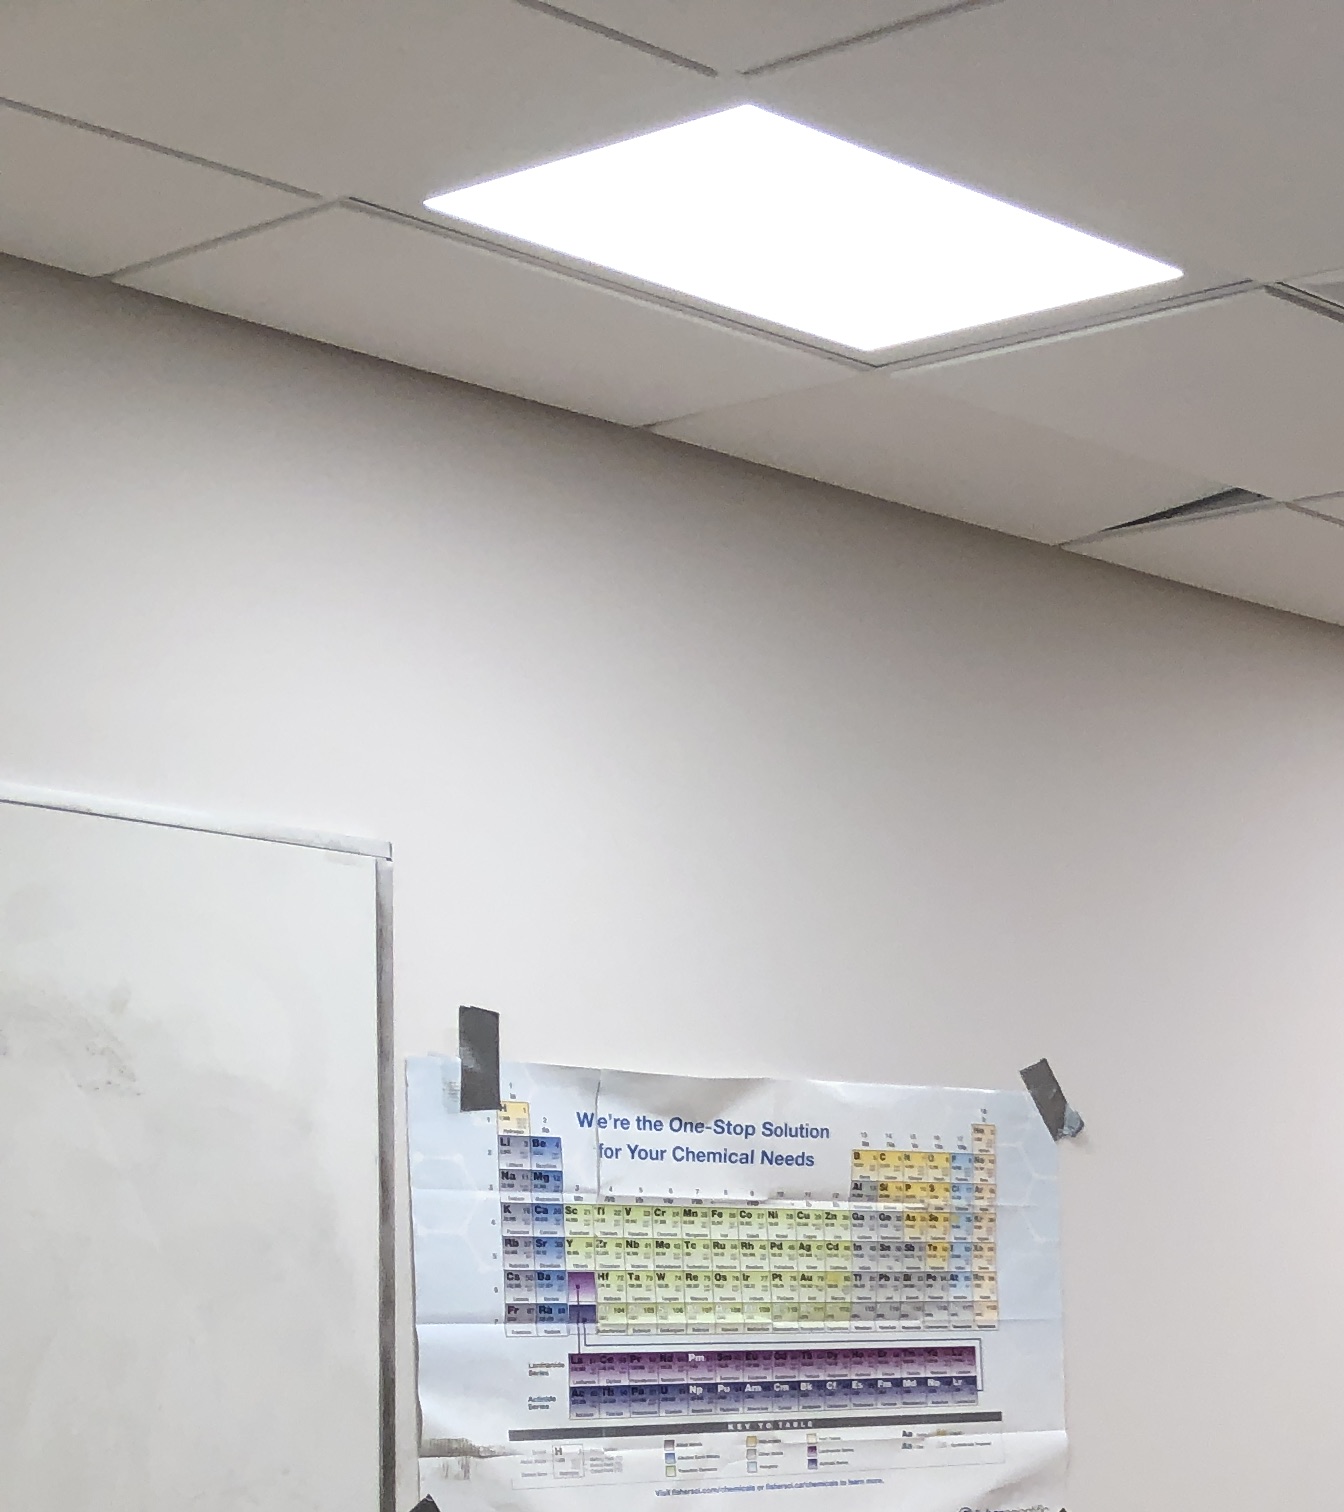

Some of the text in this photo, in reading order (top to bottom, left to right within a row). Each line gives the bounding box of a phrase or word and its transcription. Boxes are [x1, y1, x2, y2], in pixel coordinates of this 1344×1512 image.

[576, 1112, 830, 1139] We're the One-Stop Solution
[599, 1143, 815, 1167] for Your Chemical Needs
[502, 1172, 515, 1180] Na
[533, 1173, 549, 1183] Mg
[503, 1205, 512, 1214] K
[565, 1207, 577, 1215] Sc
[596, 1207, 605, 1215] Ti
[625, 1208, 632, 1216] V
[654, 1208, 666, 1216] Cr
[683, 1209, 698, 1217] Mn
[712, 1210, 723, 1218] Fe
[740, 1210, 752, 1218] Co
[768, 1211, 778, 1219] Ni
[825, 1212, 837, 1220] Zn
[505, 1239, 519, 1248] Rb
[567, 1240, 573, 1248] Y
[596, 1240, 607, 1248] Zr
[626, 1240, 639, 1248] Nb
[656, 1241, 670, 1249] Mo
[686, 1273, 698, 1281] Re
[715, 1273, 727, 1281] Os
[742, 1273, 750, 1281] Ir
